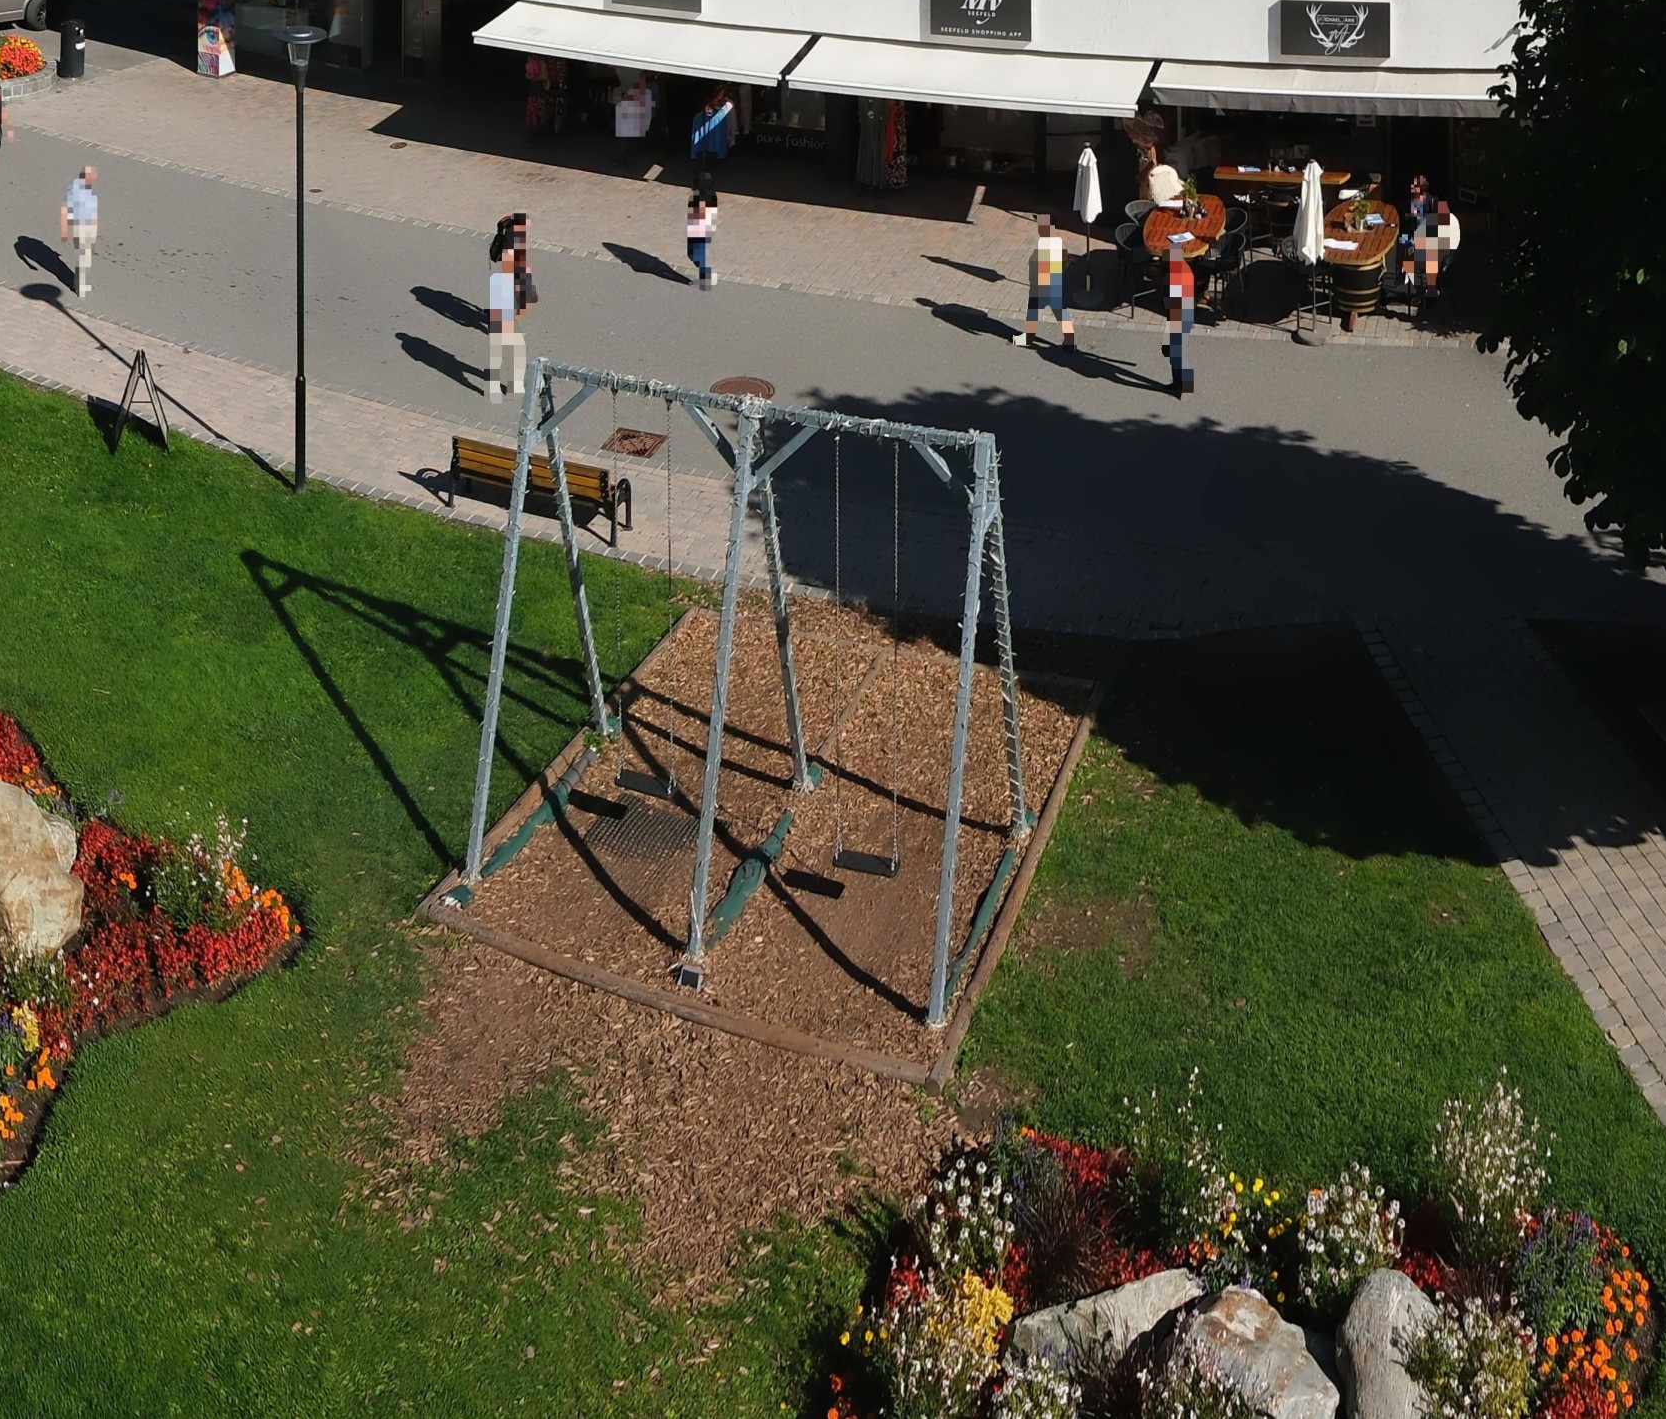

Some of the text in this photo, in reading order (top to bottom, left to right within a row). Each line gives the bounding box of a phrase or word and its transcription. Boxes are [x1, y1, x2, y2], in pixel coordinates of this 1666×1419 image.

[968, 10, 996, 18] SEEFELD
[941, 26, 970, 34] SEEFELD
[972, 28, 1007, 36] SHOPPING
[757, 133, 782, 145] pure
